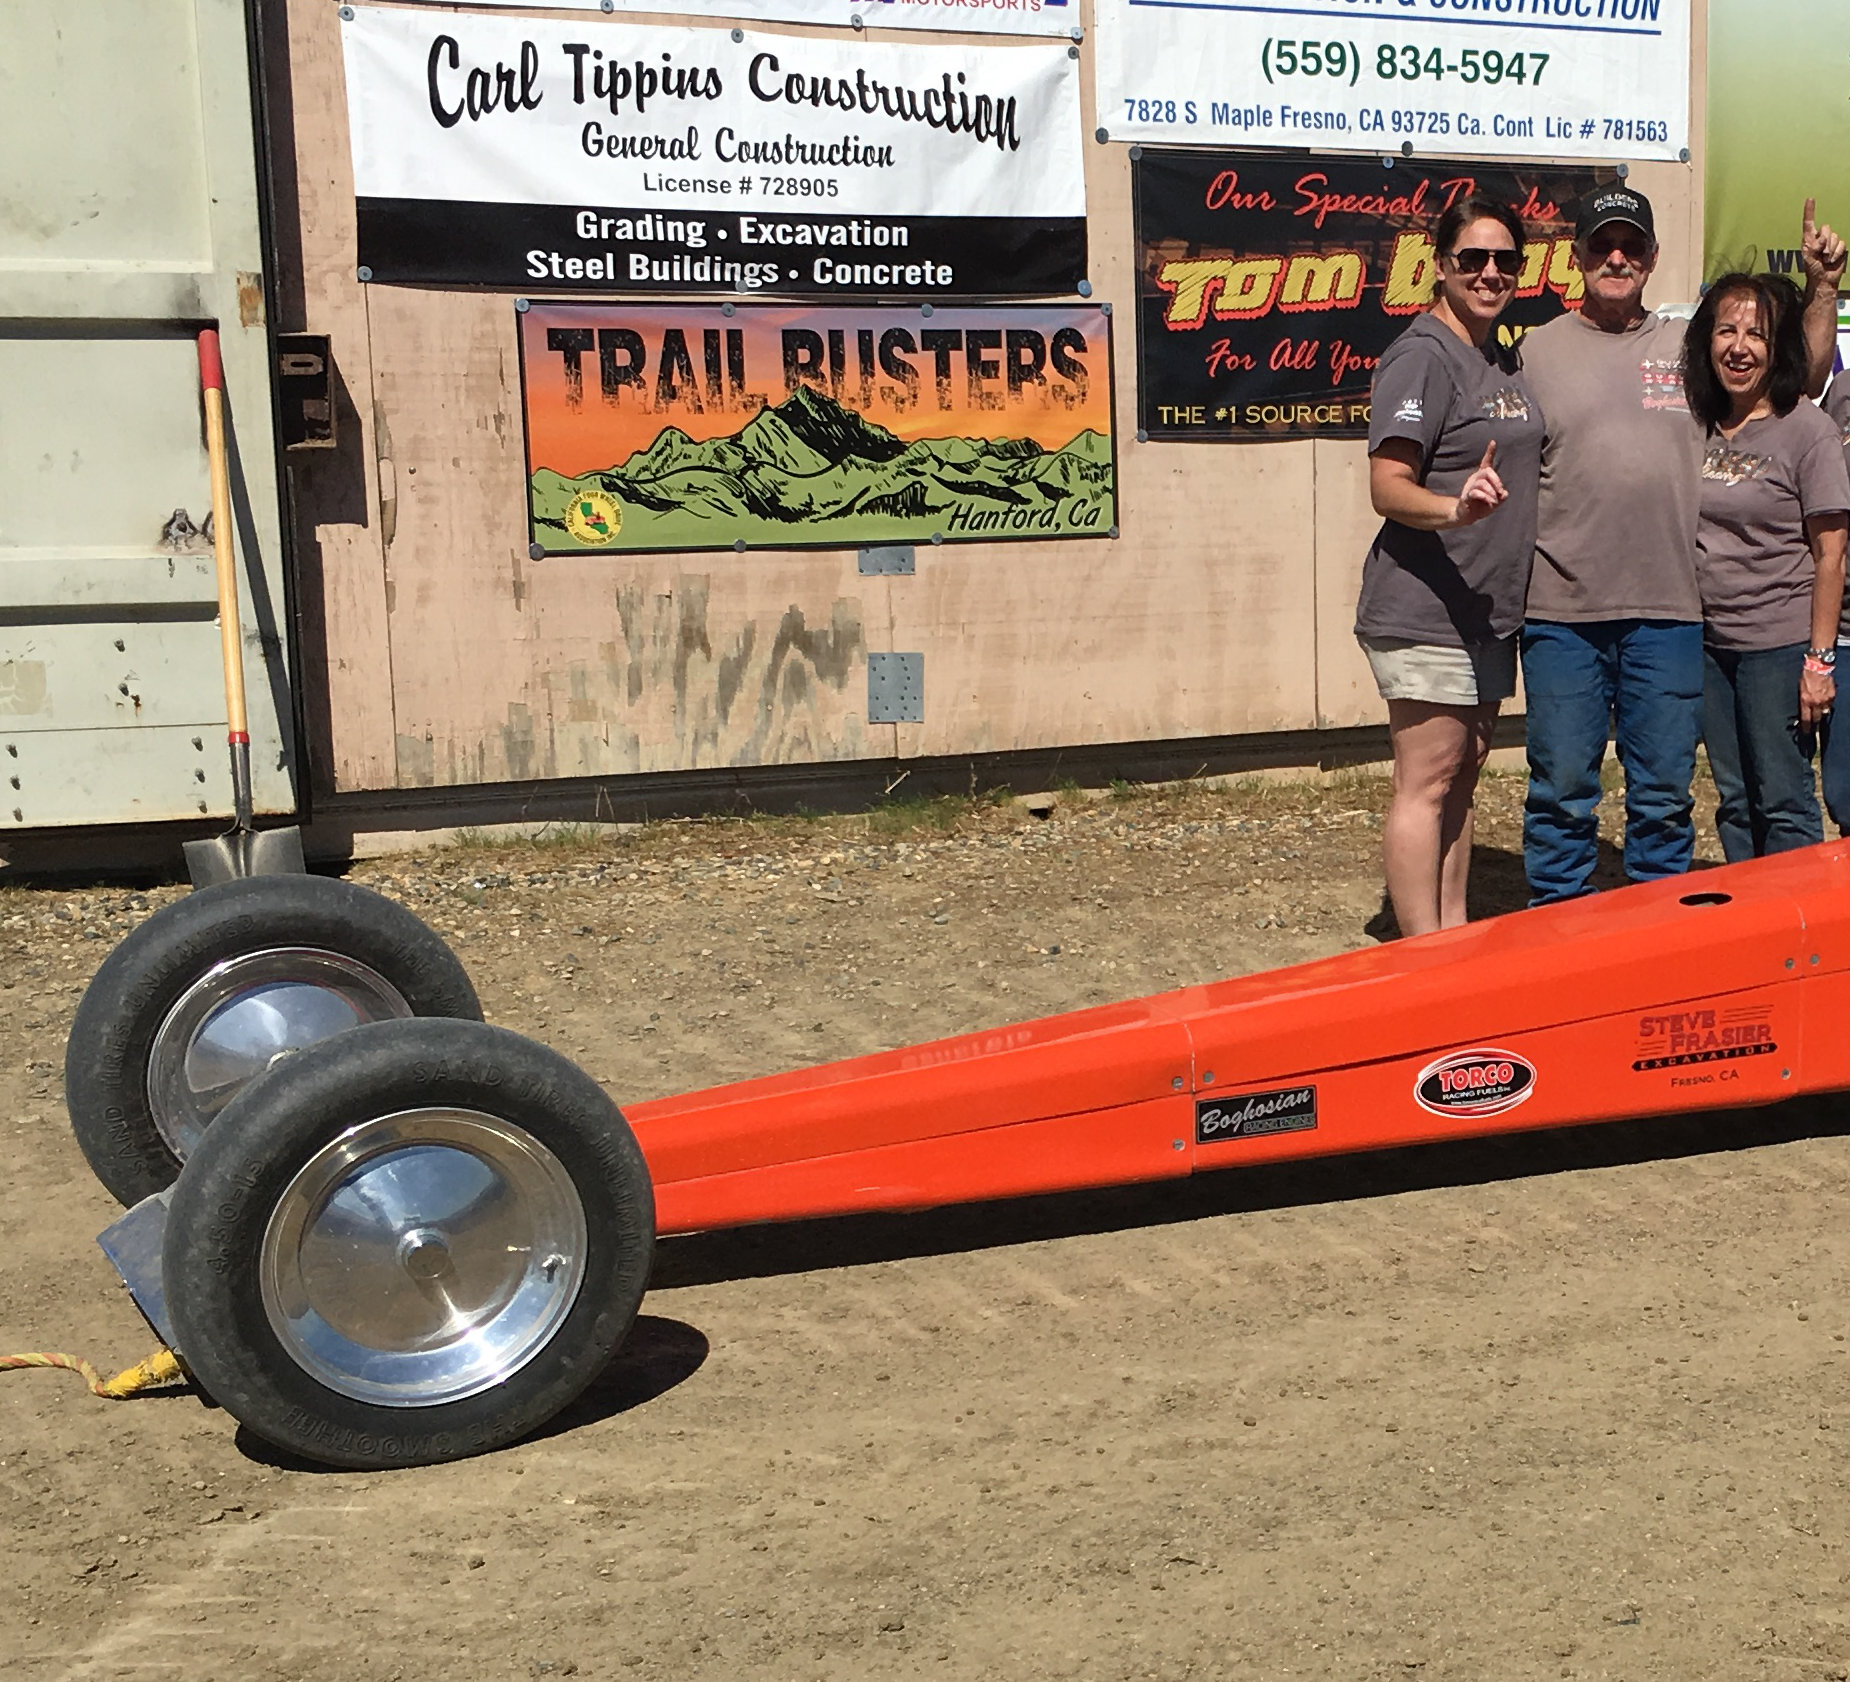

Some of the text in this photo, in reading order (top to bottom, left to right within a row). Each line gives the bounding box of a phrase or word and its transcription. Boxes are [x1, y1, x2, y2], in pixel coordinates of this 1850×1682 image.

[1261, 37, 1550, 86] (559) 834-5947
[428, 34, 1020, 151] Carl Tippins Construction
[1124, 98, 1668, 142] 7828 S Maple Fresno, CA 93725 Ca. Cont Lic # 781563
[581, 121, 895, 169] General Construction
[643, 172, 839, 197] License # 728905
[1205, 170, 1278, 211] Our
[1294, 172, 1426, 229] Special
[576, 211, 909, 247] Grading Excavation
[526, 249, 953, 287] Steel Buildings Concrete
[546, 327, 1089, 415] TRAIL BUSTERS
[1205, 338, 1380, 386] For All You
[1158, 406, 1206, 425] THE
[1214, 406, 1238, 424] #1
[1245, 405, 1343, 424] SOURCE
[947, 500, 1102, 533] Hanford, Ca
[1640, 1010, 1716, 1037] STEVE
[1670, 1024, 1772, 1054] FRASIER
[1641, 1045, 1770, 1069] EXCAVATION
[1720, 1069, 1740, 1081] CA
[1439, 1062, 1514, 1093] TORCO
[1201, 1090, 1310, 1134] Boghosian
